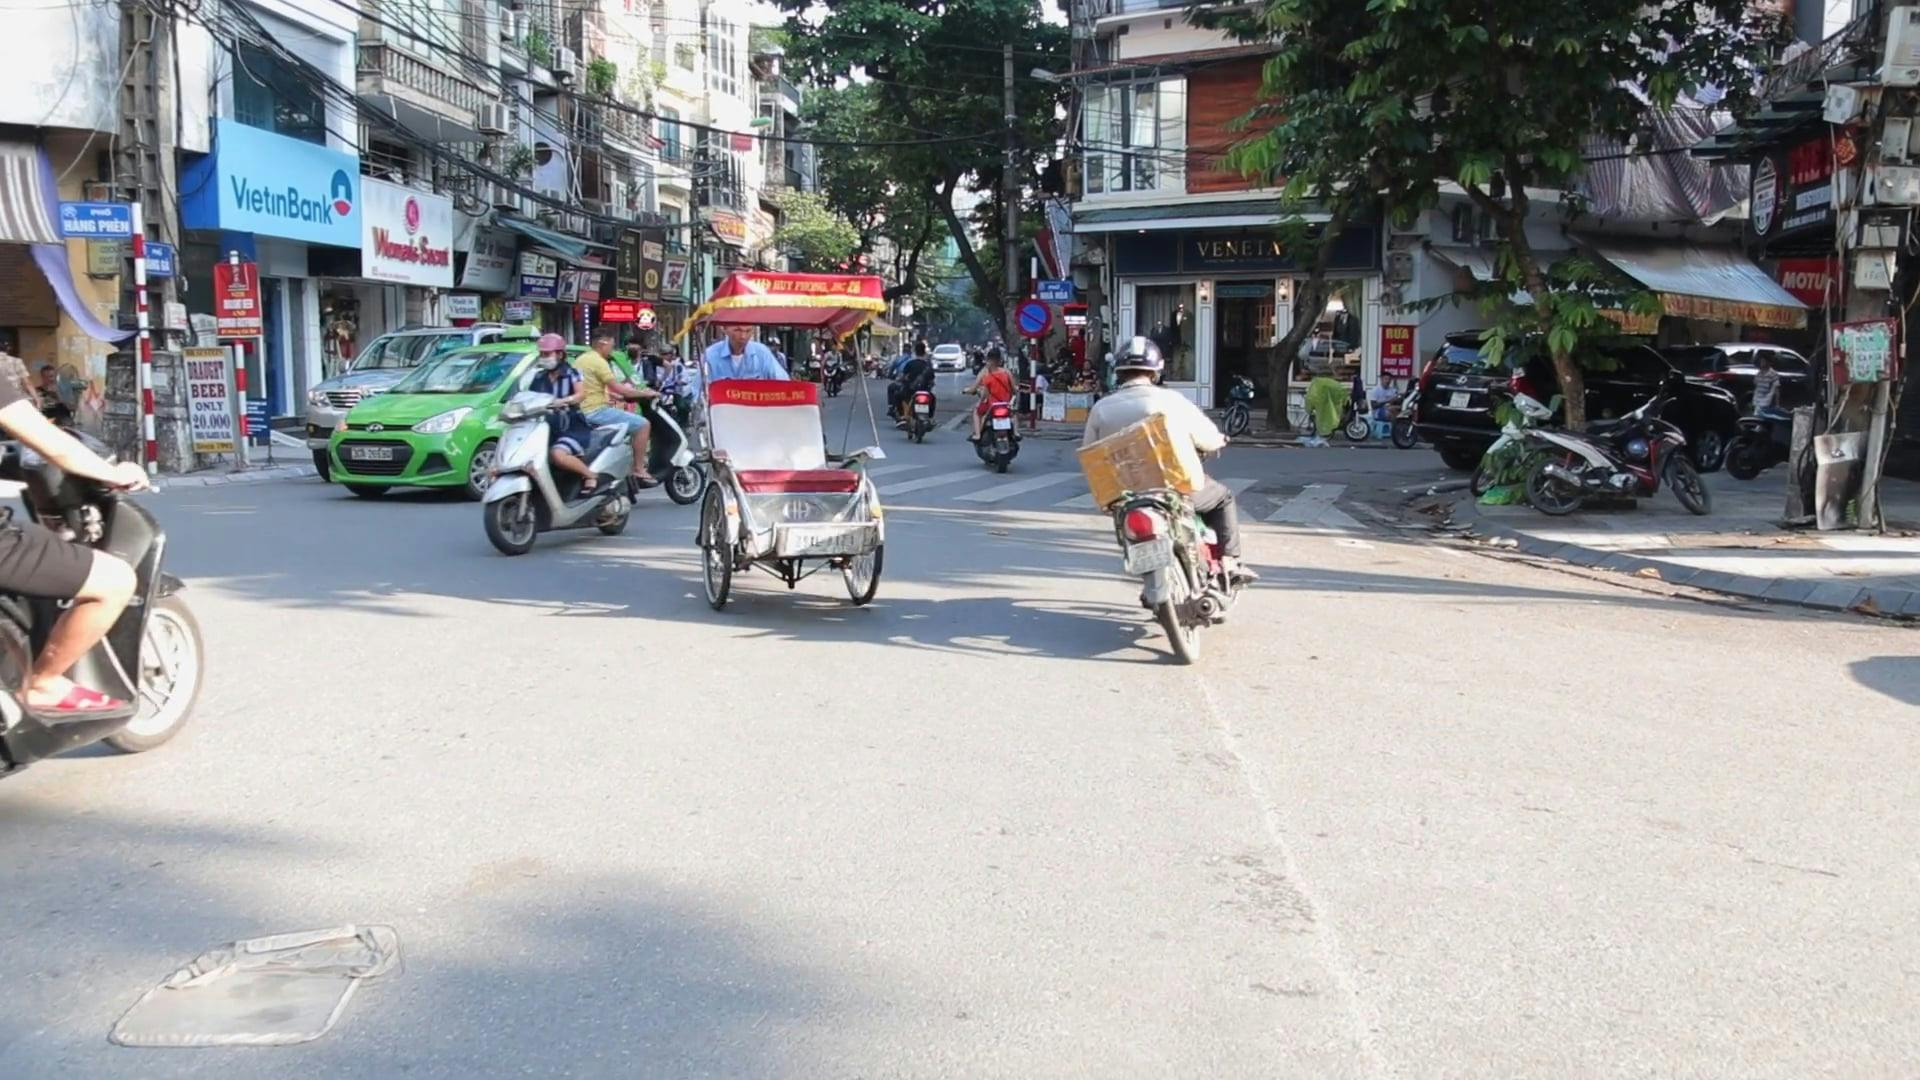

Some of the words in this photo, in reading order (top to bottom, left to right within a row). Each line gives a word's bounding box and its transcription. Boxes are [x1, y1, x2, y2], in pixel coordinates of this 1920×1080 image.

[230, 174, 333, 225] VietinBank
[1196, 240, 1282, 257] VENETA
[191, 384, 226, 398] BEER
[195, 401, 224, 411] ONLY
